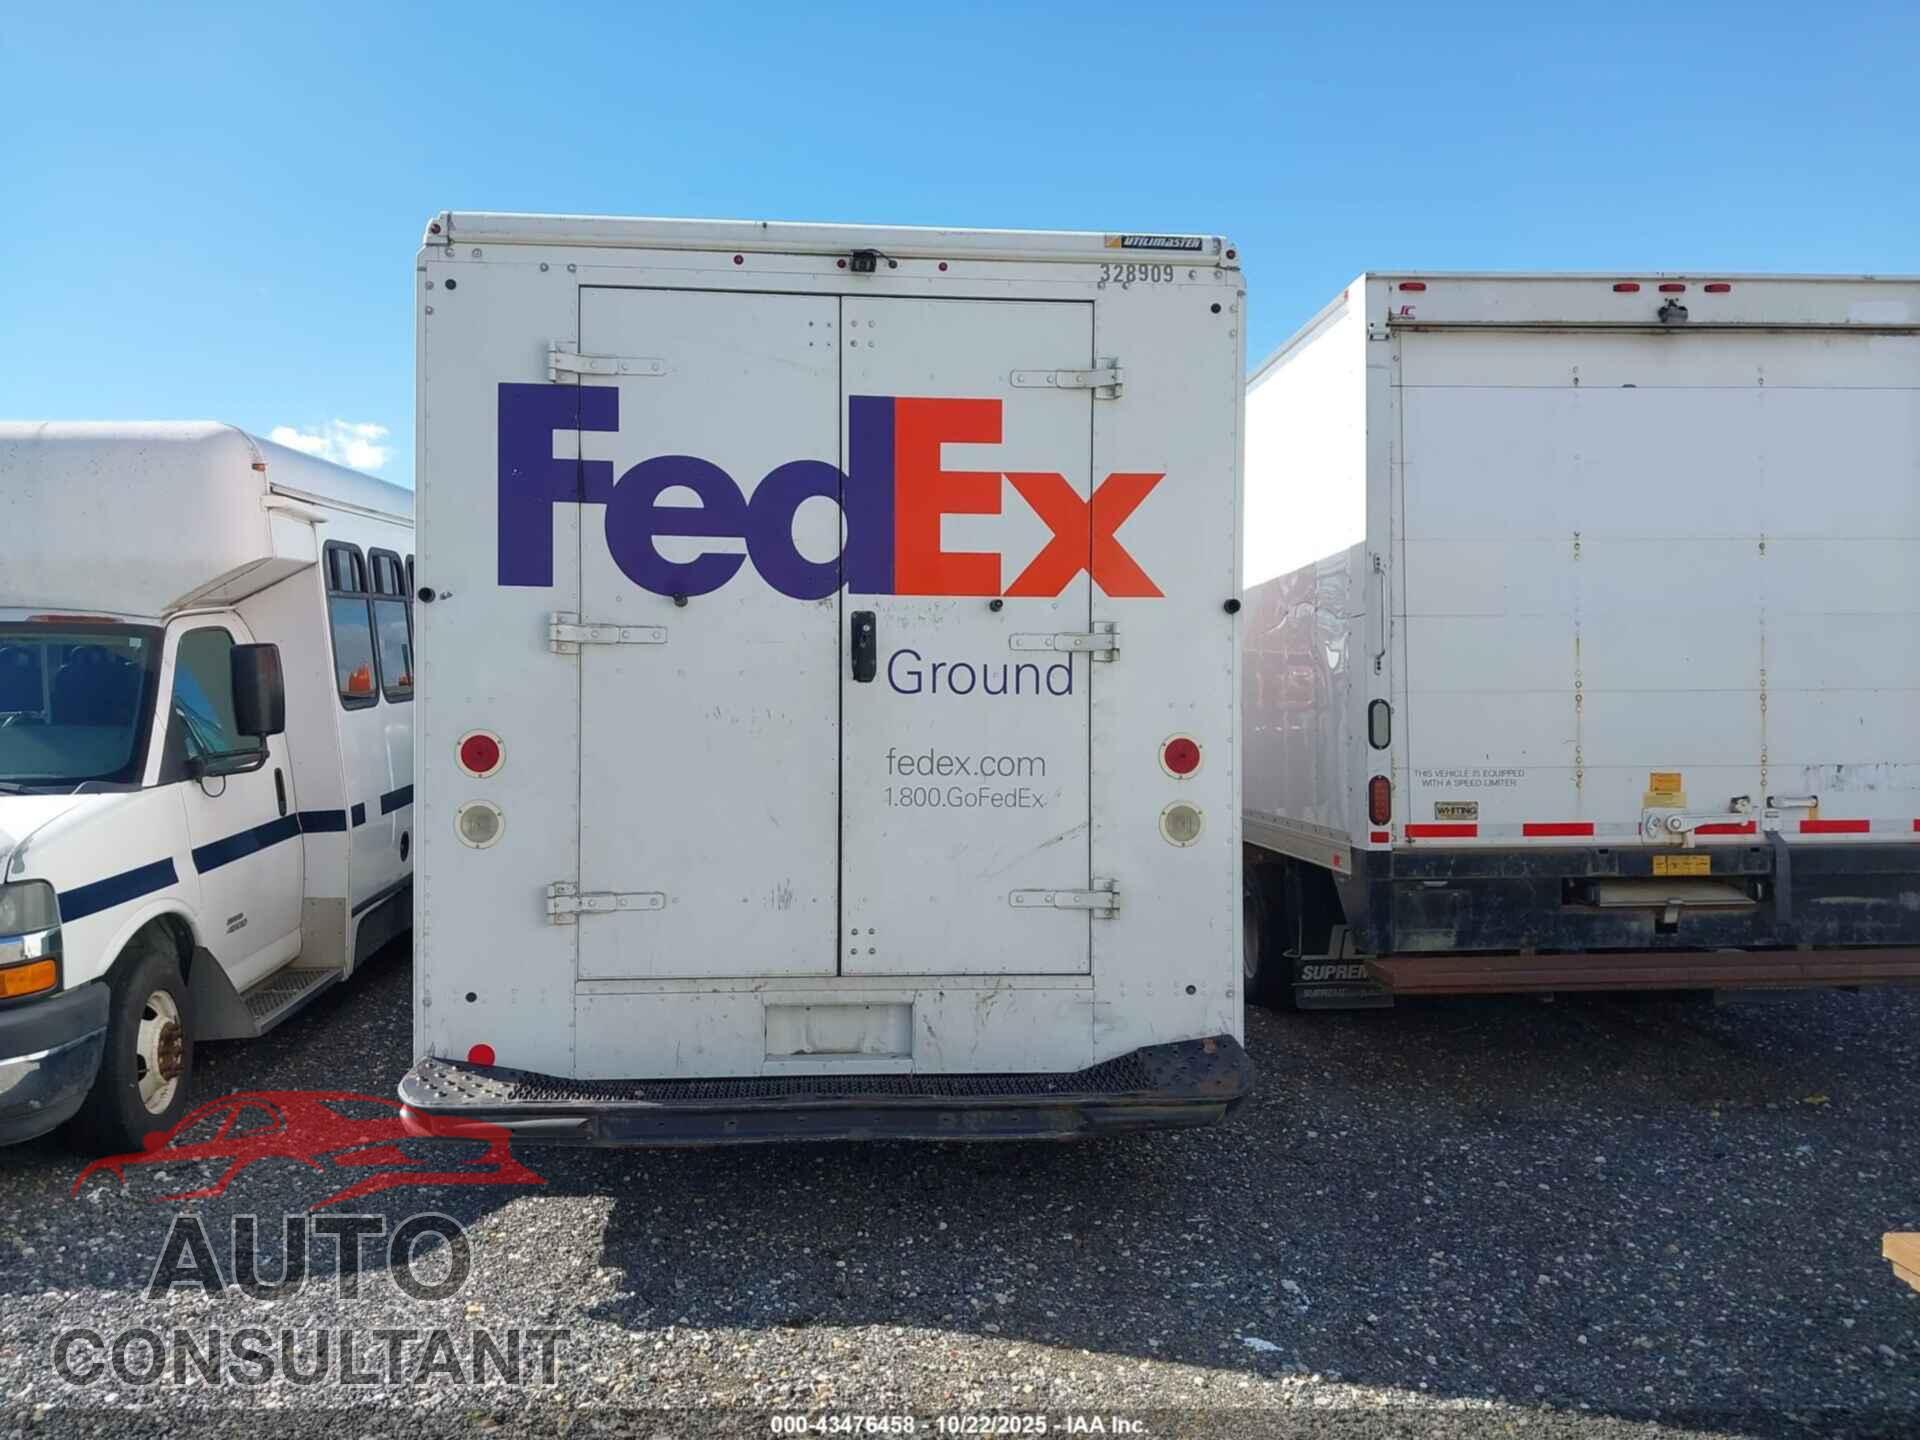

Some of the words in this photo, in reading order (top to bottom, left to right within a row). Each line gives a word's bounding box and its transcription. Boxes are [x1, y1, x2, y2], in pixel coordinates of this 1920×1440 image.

[1100, 263, 1174, 283] 328909
[498, 382, 1166, 600] FedEx
[887, 648, 1073, 696] Ground
[885, 747, 1046, 777] fedex.com
